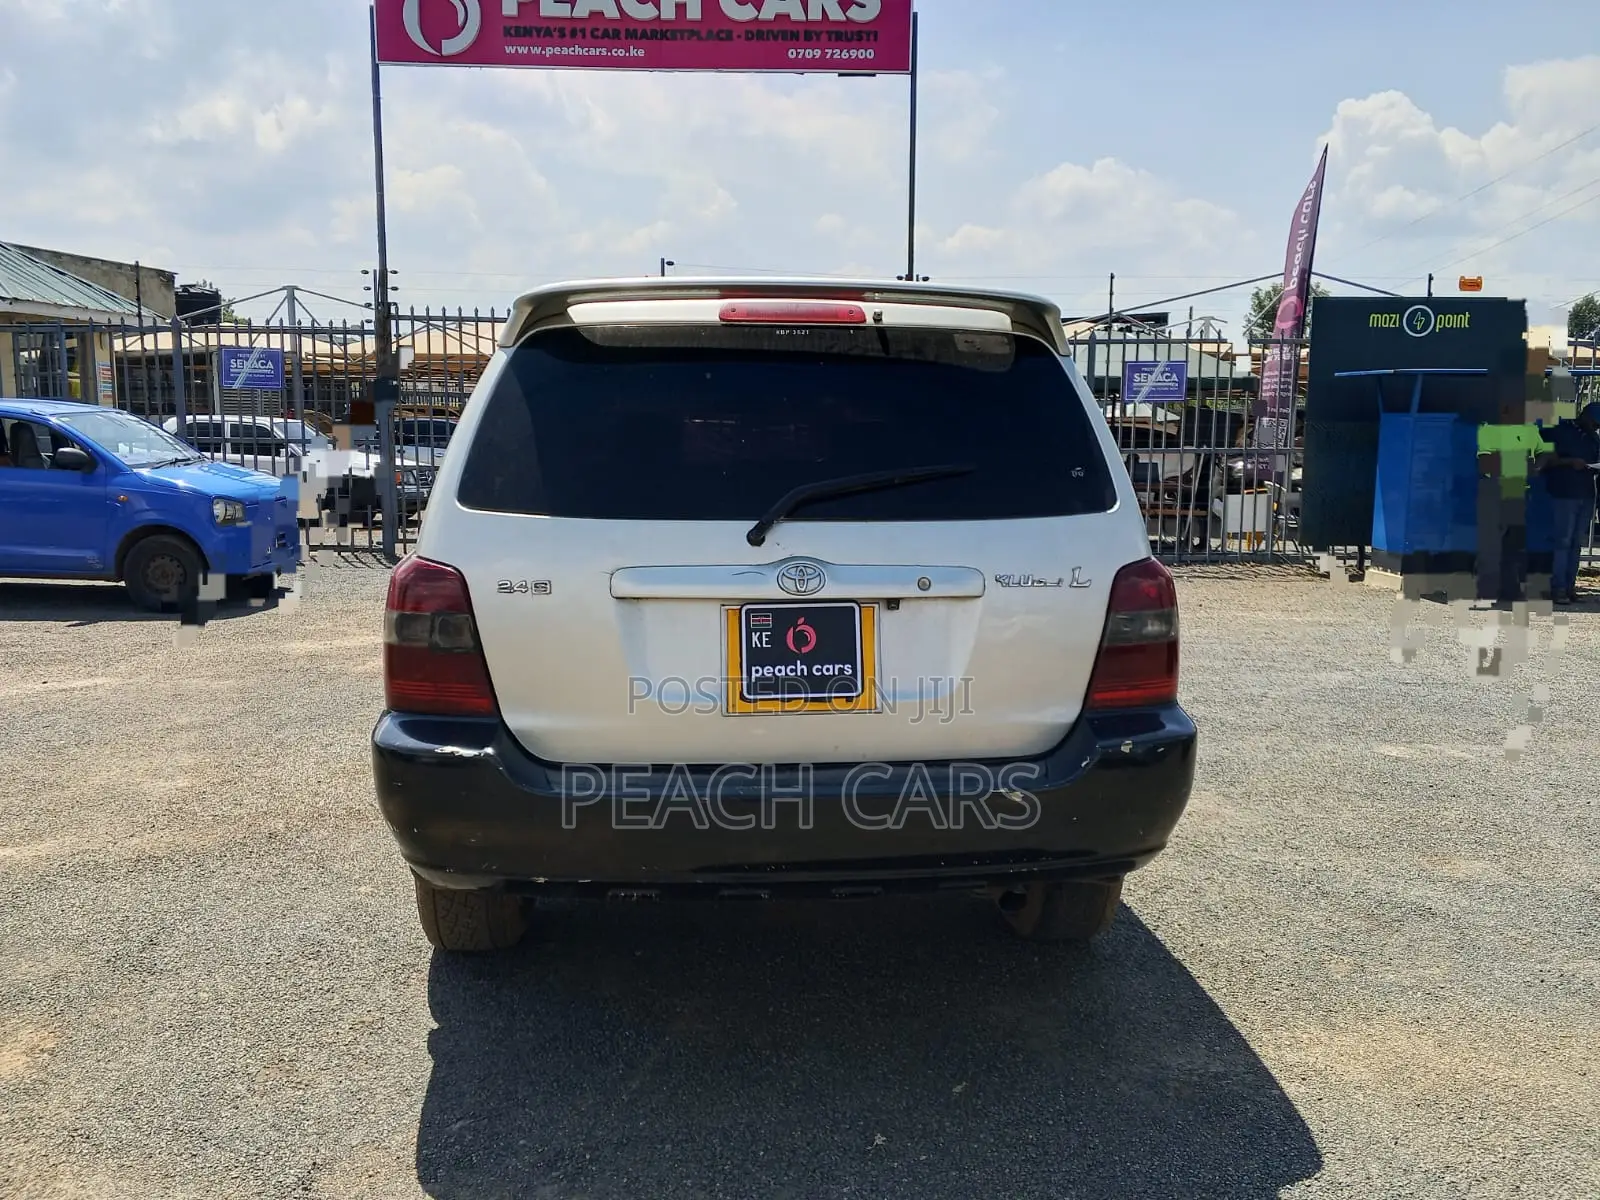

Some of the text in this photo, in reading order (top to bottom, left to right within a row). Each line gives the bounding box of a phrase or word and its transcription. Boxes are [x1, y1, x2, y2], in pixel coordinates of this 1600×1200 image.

[503, 26, 566, 39] KENYA'S
[569, 28, 586, 39] #1
[590, 28, 621, 40] CAR
[625, 28, 733, 41] MARKETPLACE
[744, 29, 799, 41] DRIVEN
[804, 30, 822, 41] BY
[825, 30, 878, 42] TRUST!
[504, 45, 645, 57] www.peachcars.co.ke
[788, 48, 874, 59] 0709 726900
[1435, 312, 1470, 332] point
[751, 631, 772, 648] KE
[751, 659, 853, 682] peach cars
